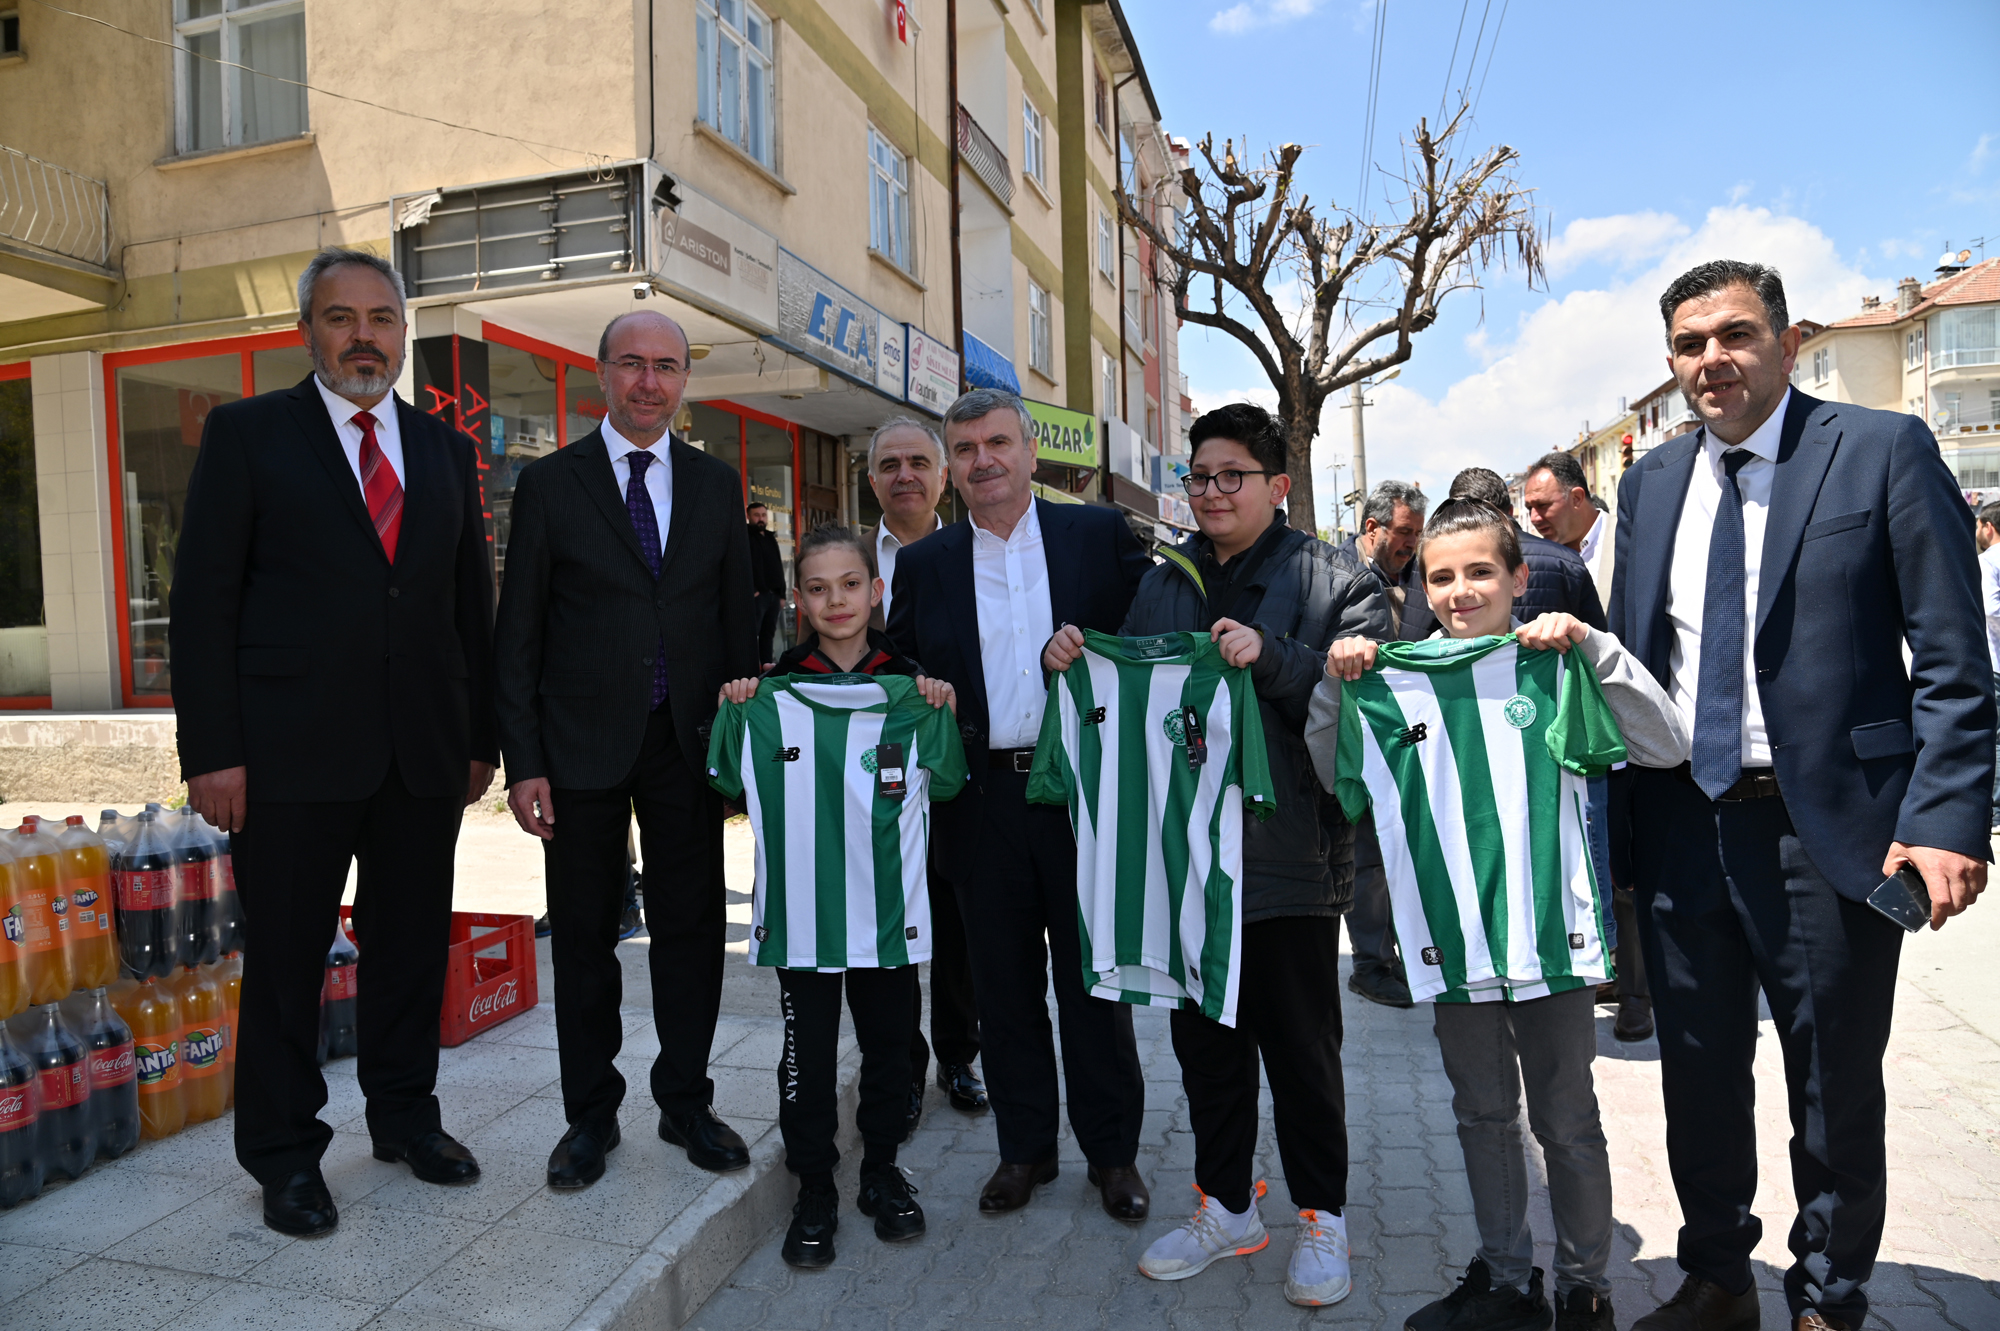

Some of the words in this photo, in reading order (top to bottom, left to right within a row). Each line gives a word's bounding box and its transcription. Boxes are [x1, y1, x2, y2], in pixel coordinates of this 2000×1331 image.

[680, 235, 728, 269] ARISTON
[1033, 419, 1083, 454] PAZAR
[52, 898, 68, 913] FANT
[71, 890, 99, 904] FANTA
[782, 989, 795, 1021] AIR
[181, 1033, 223, 1060] FANTA
[137, 1049, 176, 1074] ANTA
[786, 1028, 799, 1102] JORDAN
